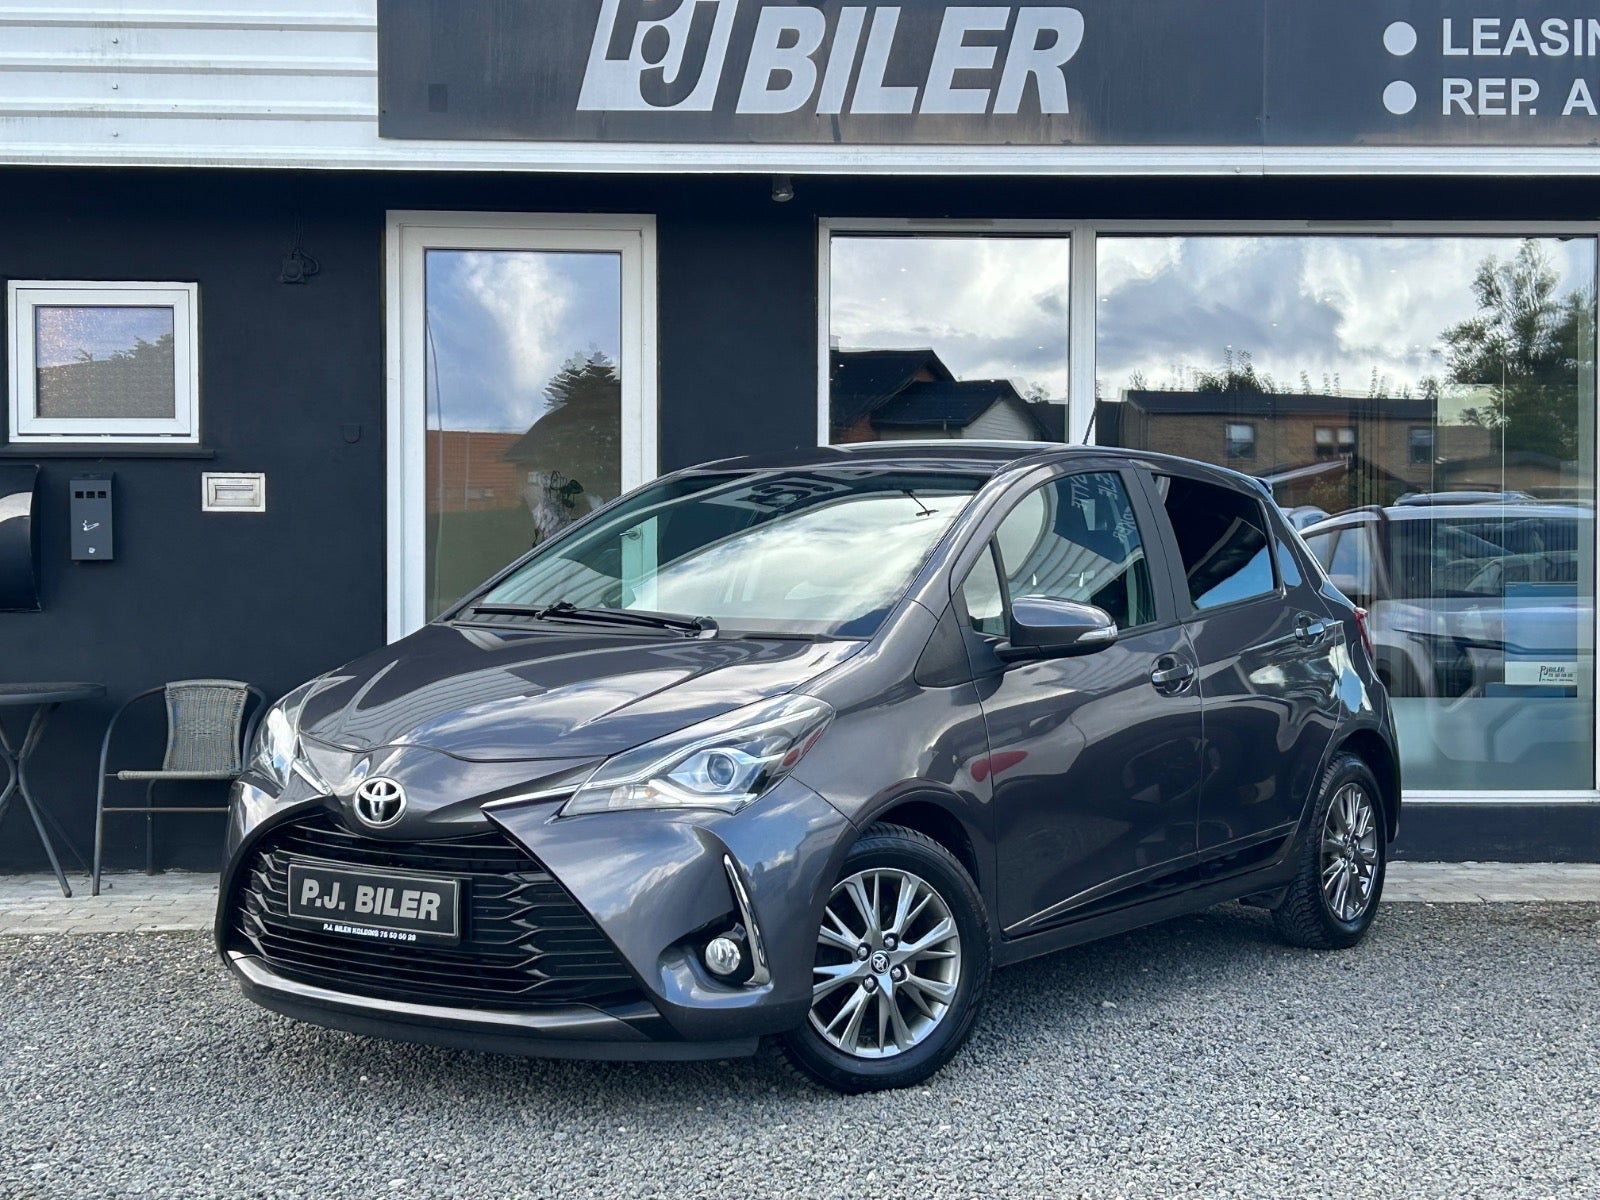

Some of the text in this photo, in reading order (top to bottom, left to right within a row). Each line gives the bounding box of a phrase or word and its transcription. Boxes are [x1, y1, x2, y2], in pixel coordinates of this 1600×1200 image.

[735, 6, 1085, 115] BILER
[1442, 78, 1540, 116] REP.
[300, 878, 441, 922] P.J. BILER
